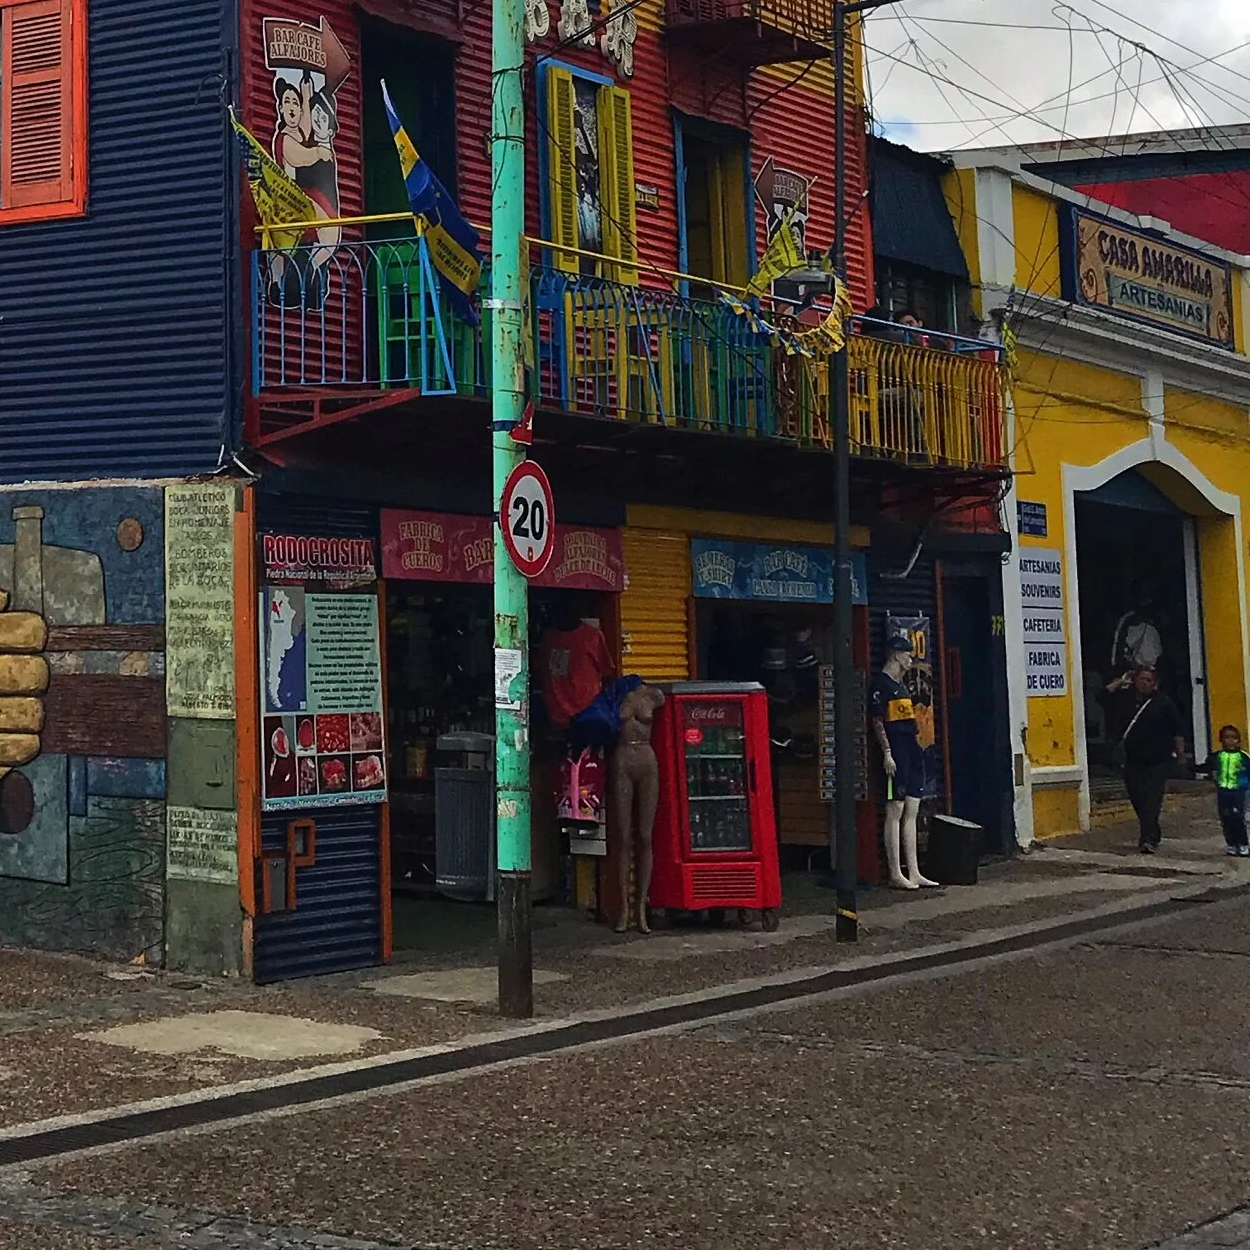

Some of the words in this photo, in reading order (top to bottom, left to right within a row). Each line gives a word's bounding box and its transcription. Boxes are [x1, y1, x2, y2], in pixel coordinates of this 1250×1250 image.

[273, 29, 295, 44] BAR
[296, 31, 321, 51] CAFE
[270, 43, 326, 67] ALFAJORES
[1098, 230, 1139, 273] CASA
[1142, 246, 1213, 298] AMARILLA
[1120, 283, 1204, 322] ARTESANIAS
[189, 493, 226, 502] ATLETICO
[513, 496, 544, 541] 20
[399, 521, 443, 542] FABRICA
[264, 535, 375, 567] RODOCROSITA
[414, 538, 430, 553] DE
[401, 552, 443, 572] CUEROS
[1019, 558, 1061, 575] ARTESANIAS
[266, 568, 285, 579] Piedra
[285, 569, 309, 580] Nacional
[310, 570, 316, 580] de
[1021, 583, 1061, 599] SOUVENIRS
[1023, 617, 1062, 633] CAFETERIA
[1028, 651, 1061, 666] FABRICA
[1026, 674, 1038, 690] DE
[1039, 675, 1065, 691] CUERO
